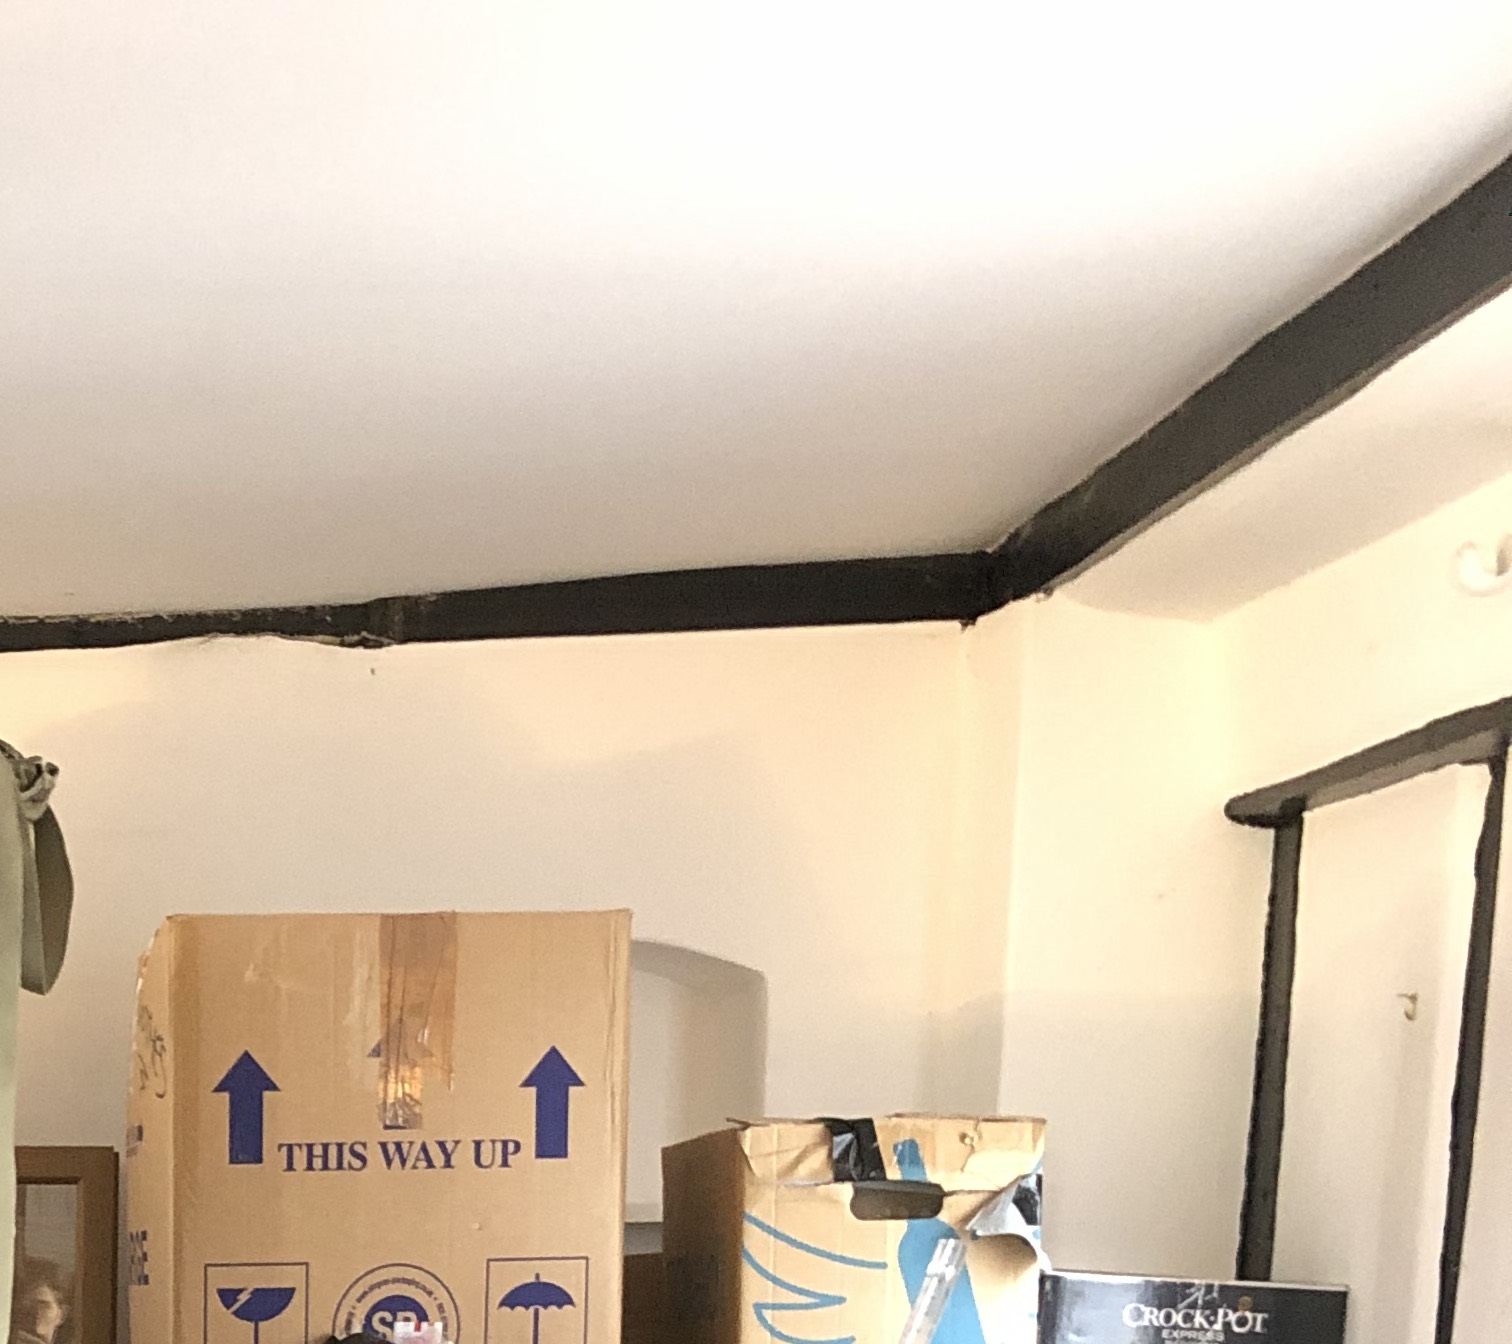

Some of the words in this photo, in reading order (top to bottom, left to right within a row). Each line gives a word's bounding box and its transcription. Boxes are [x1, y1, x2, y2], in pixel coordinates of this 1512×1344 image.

[277, 1141, 369, 1172] THIS
[378, 1140, 462, 1171] WAY
[472, 1138, 522, 1169] UP
